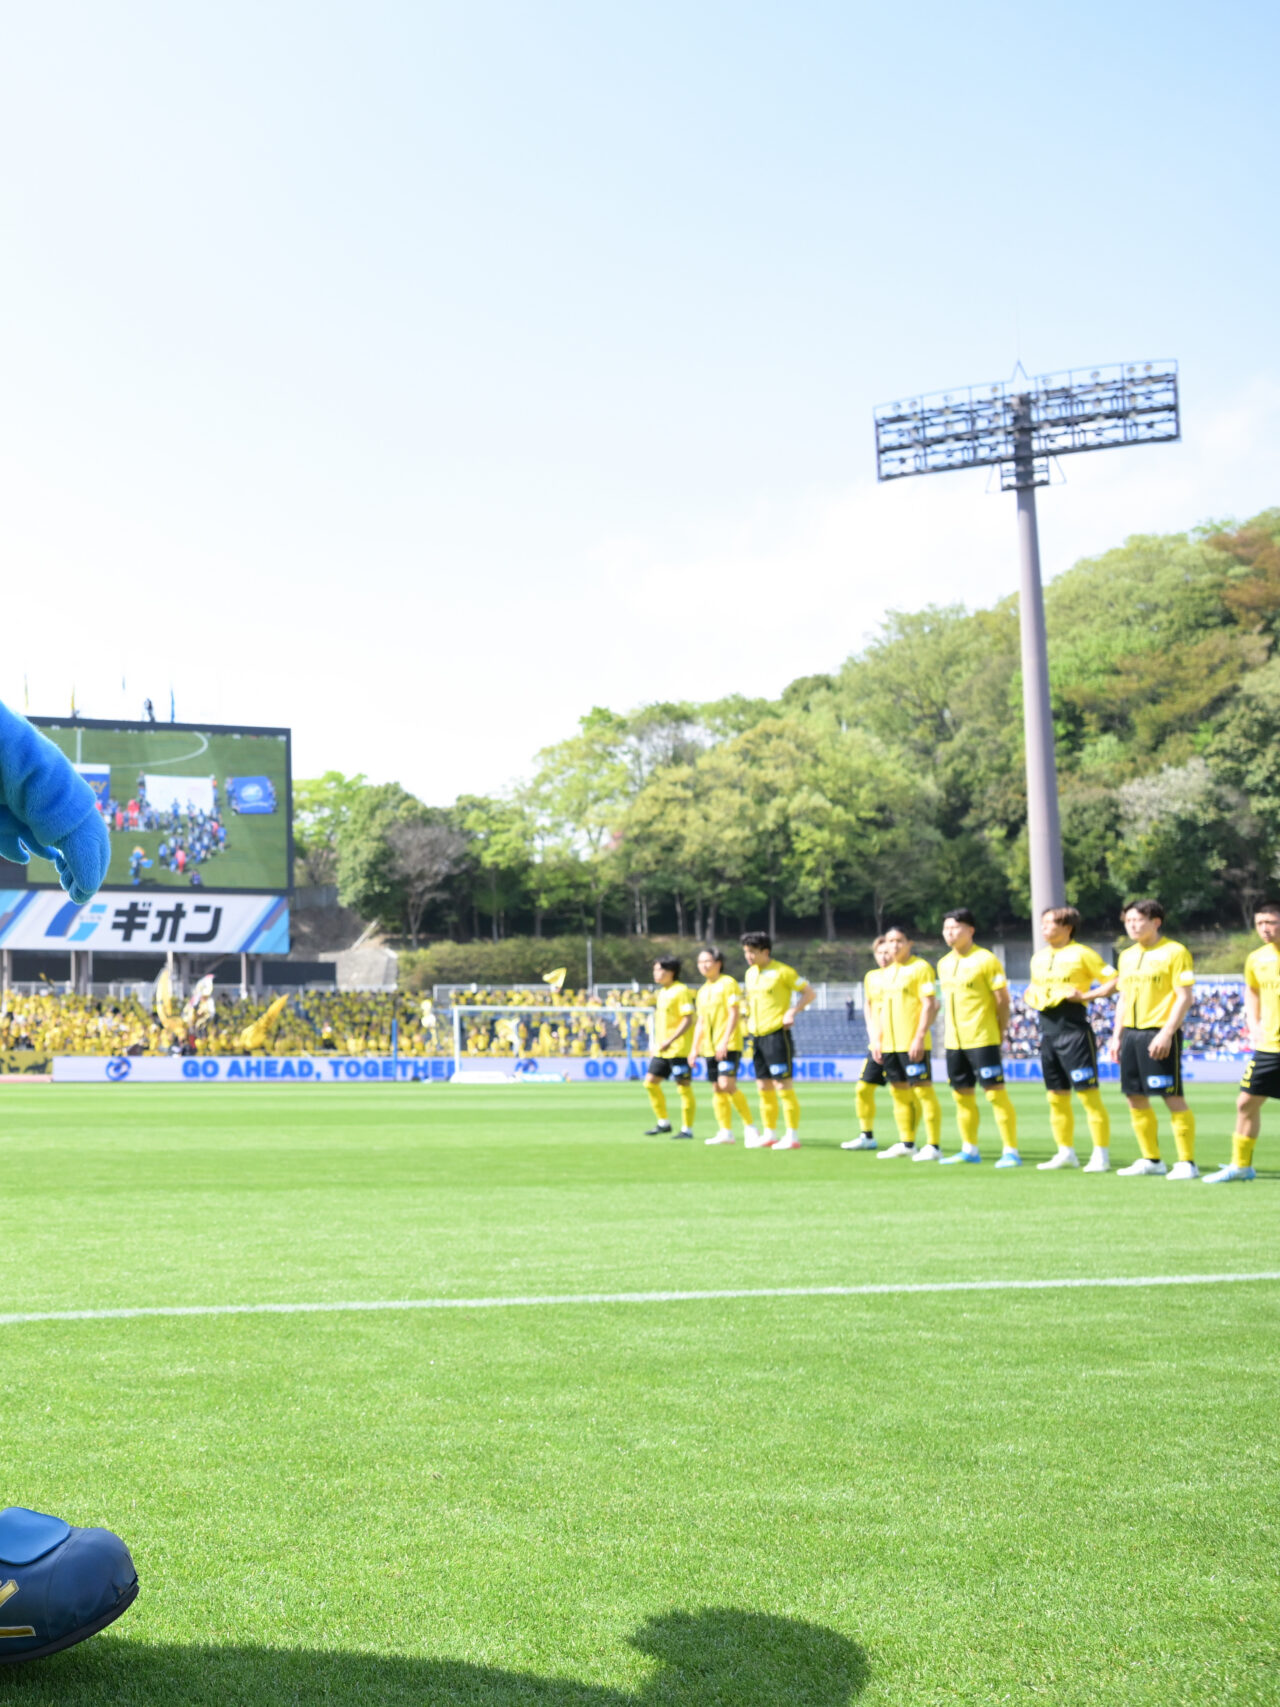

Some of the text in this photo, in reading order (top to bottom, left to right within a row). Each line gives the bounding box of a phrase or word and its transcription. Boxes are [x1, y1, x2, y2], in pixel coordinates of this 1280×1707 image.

[111, 902, 223, 943] ギオン
[182, 1060, 220, 1078] GO
[226, 1060, 322, 1080] AHEAD,
[584, 1060, 618, 1078] GO
